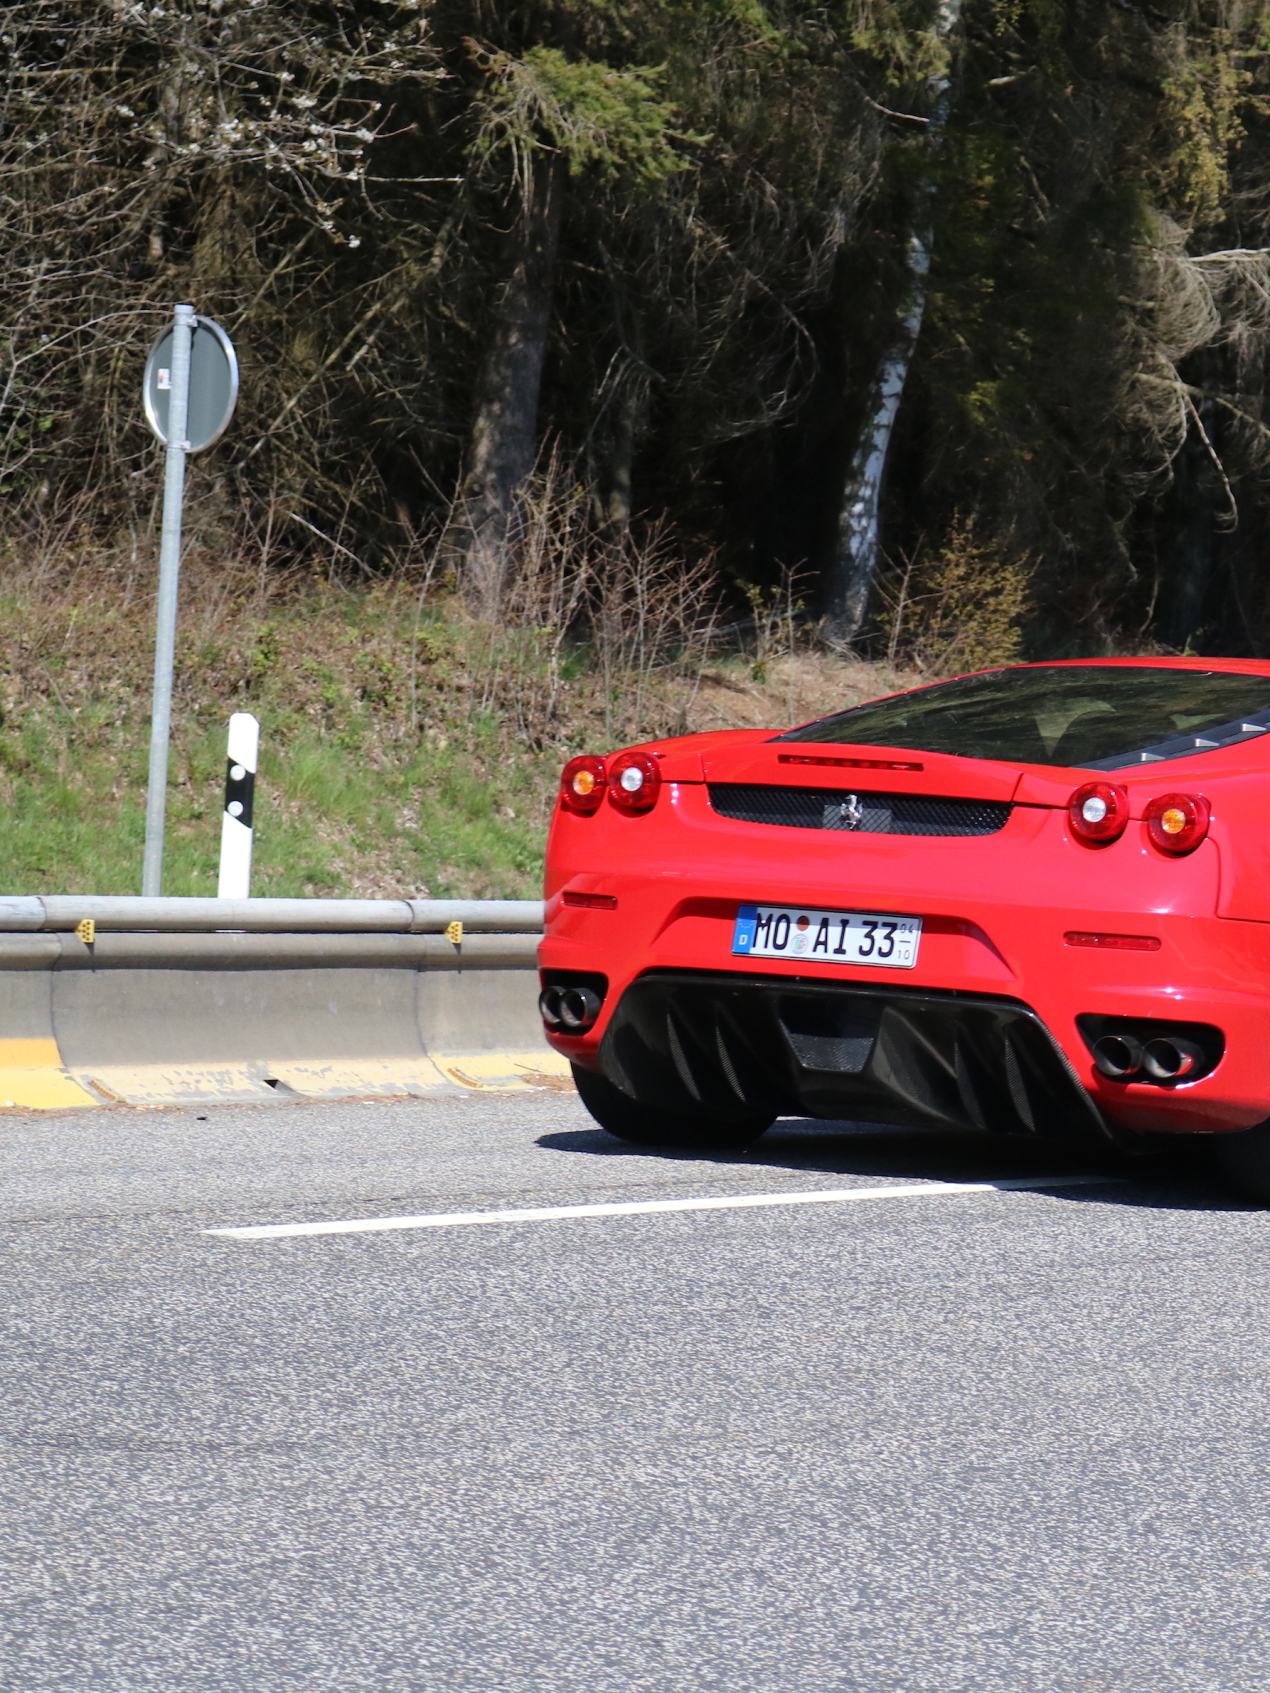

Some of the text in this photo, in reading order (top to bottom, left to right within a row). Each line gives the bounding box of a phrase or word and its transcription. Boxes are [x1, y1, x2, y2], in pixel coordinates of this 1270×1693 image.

[738, 934, 748, 946] D
[753, 912, 898, 958] MO AI 33
